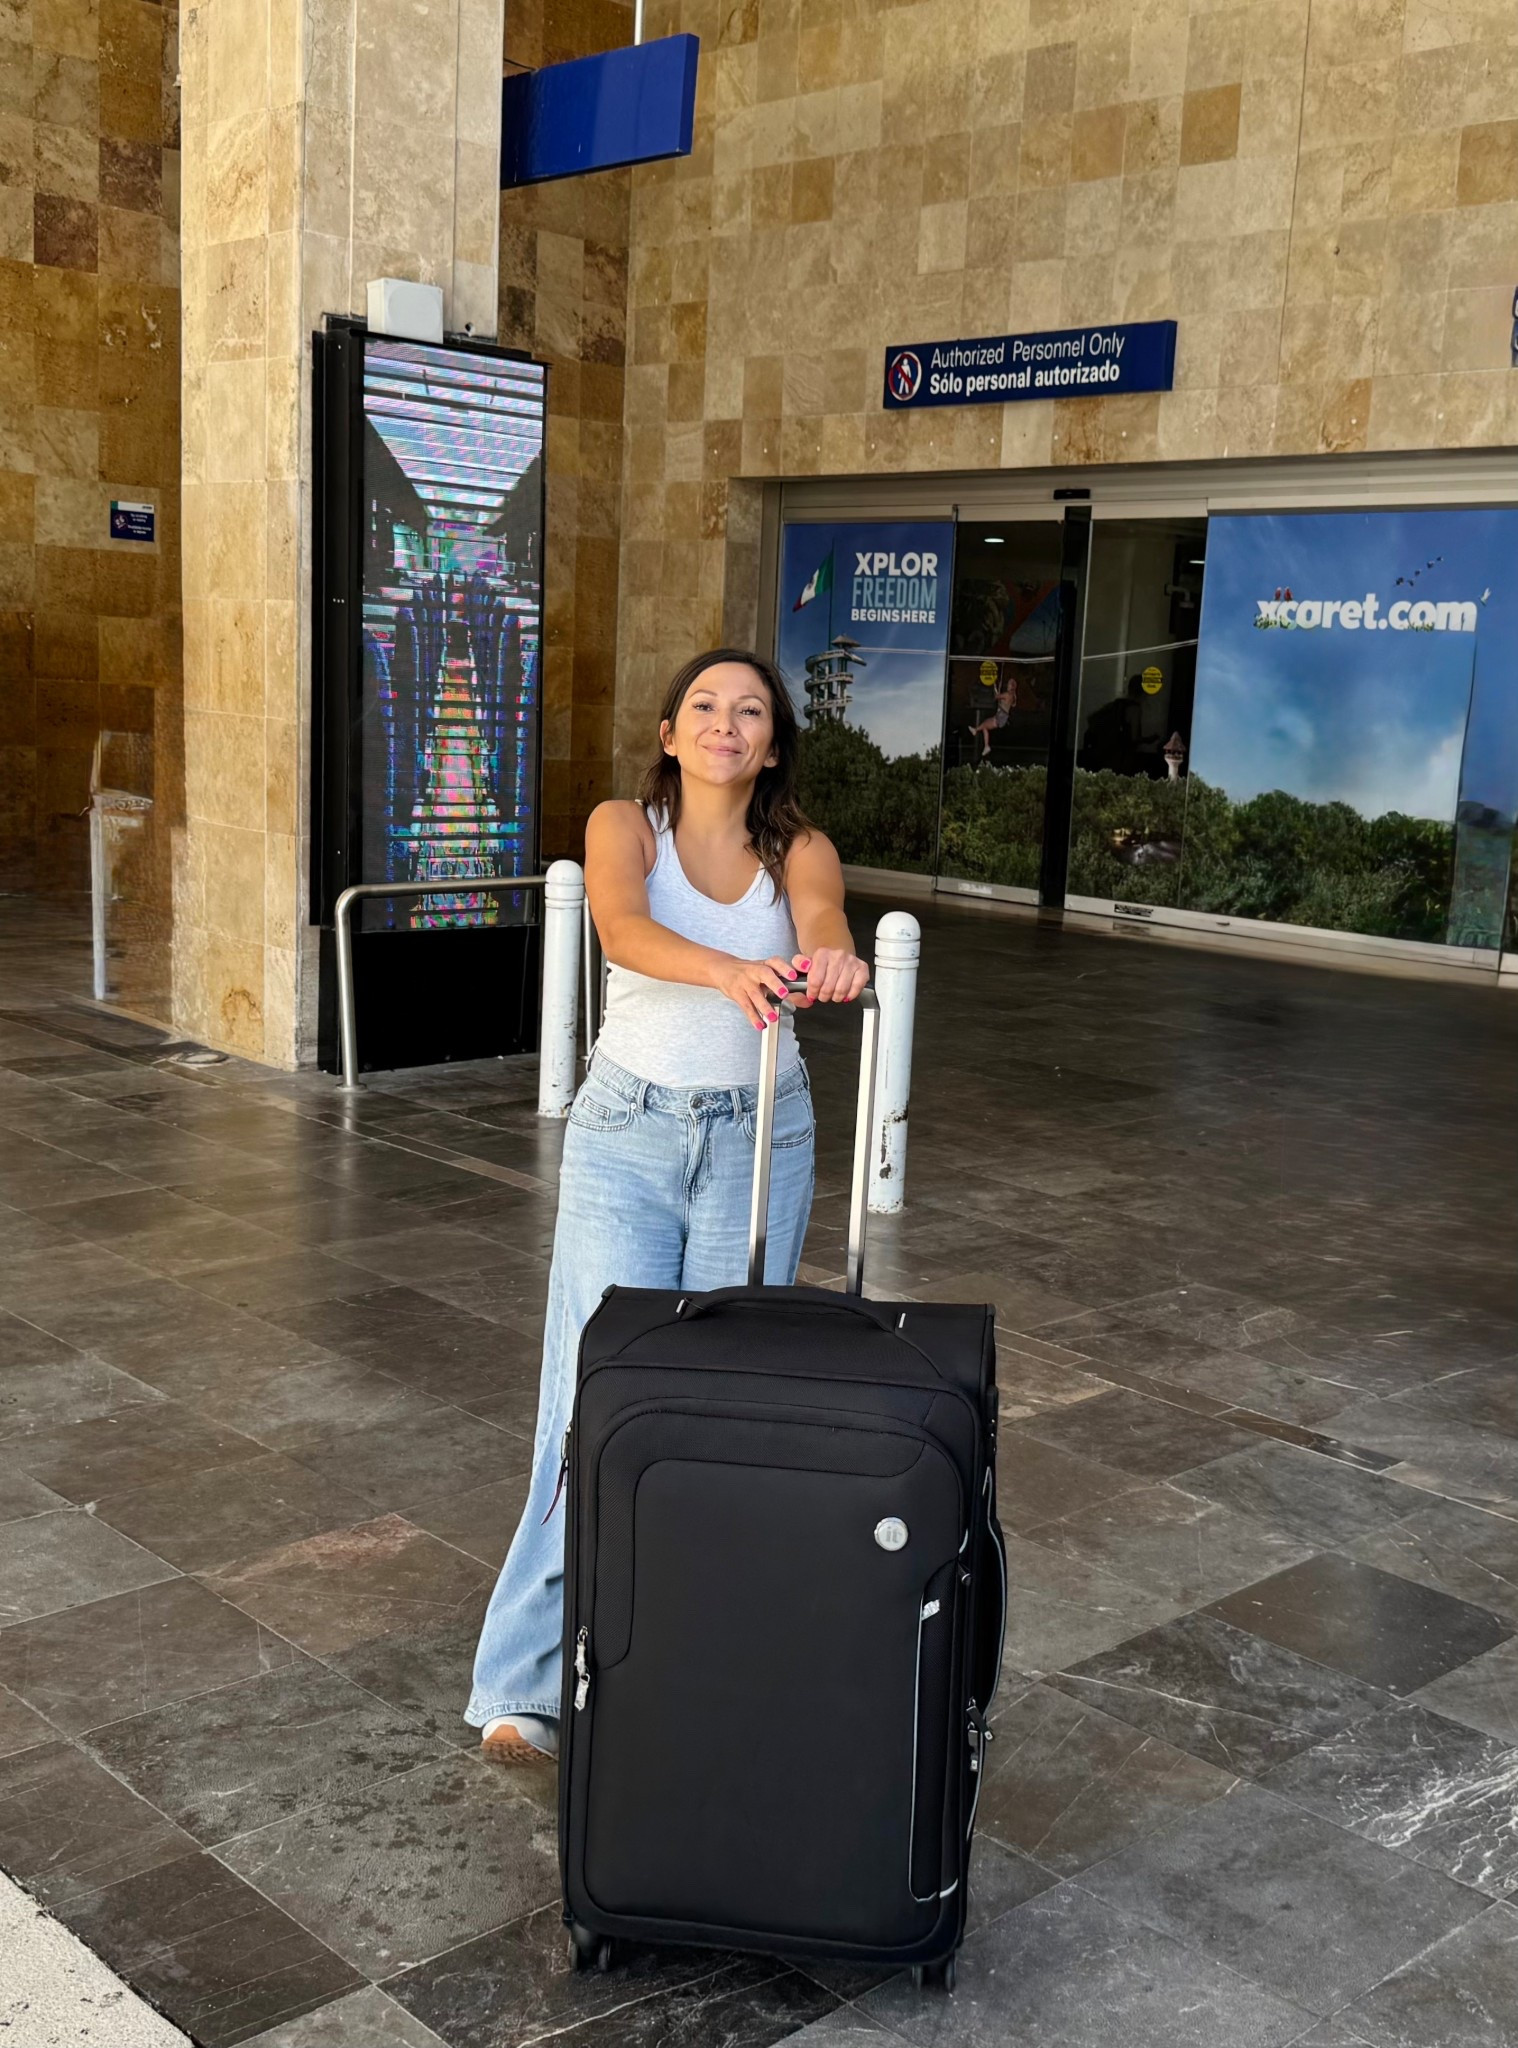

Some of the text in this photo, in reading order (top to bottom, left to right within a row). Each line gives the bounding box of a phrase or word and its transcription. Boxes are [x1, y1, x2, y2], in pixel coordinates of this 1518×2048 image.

[930, 331, 1126, 369] Authorized Personnel Only
[929, 359, 1121, 397] Sólo personal autorizado
[854, 552, 938, 577] XPLOR
[852, 577, 938, 609] FREEDOM
[1255, 593, 1478, 633] xcaret.com
